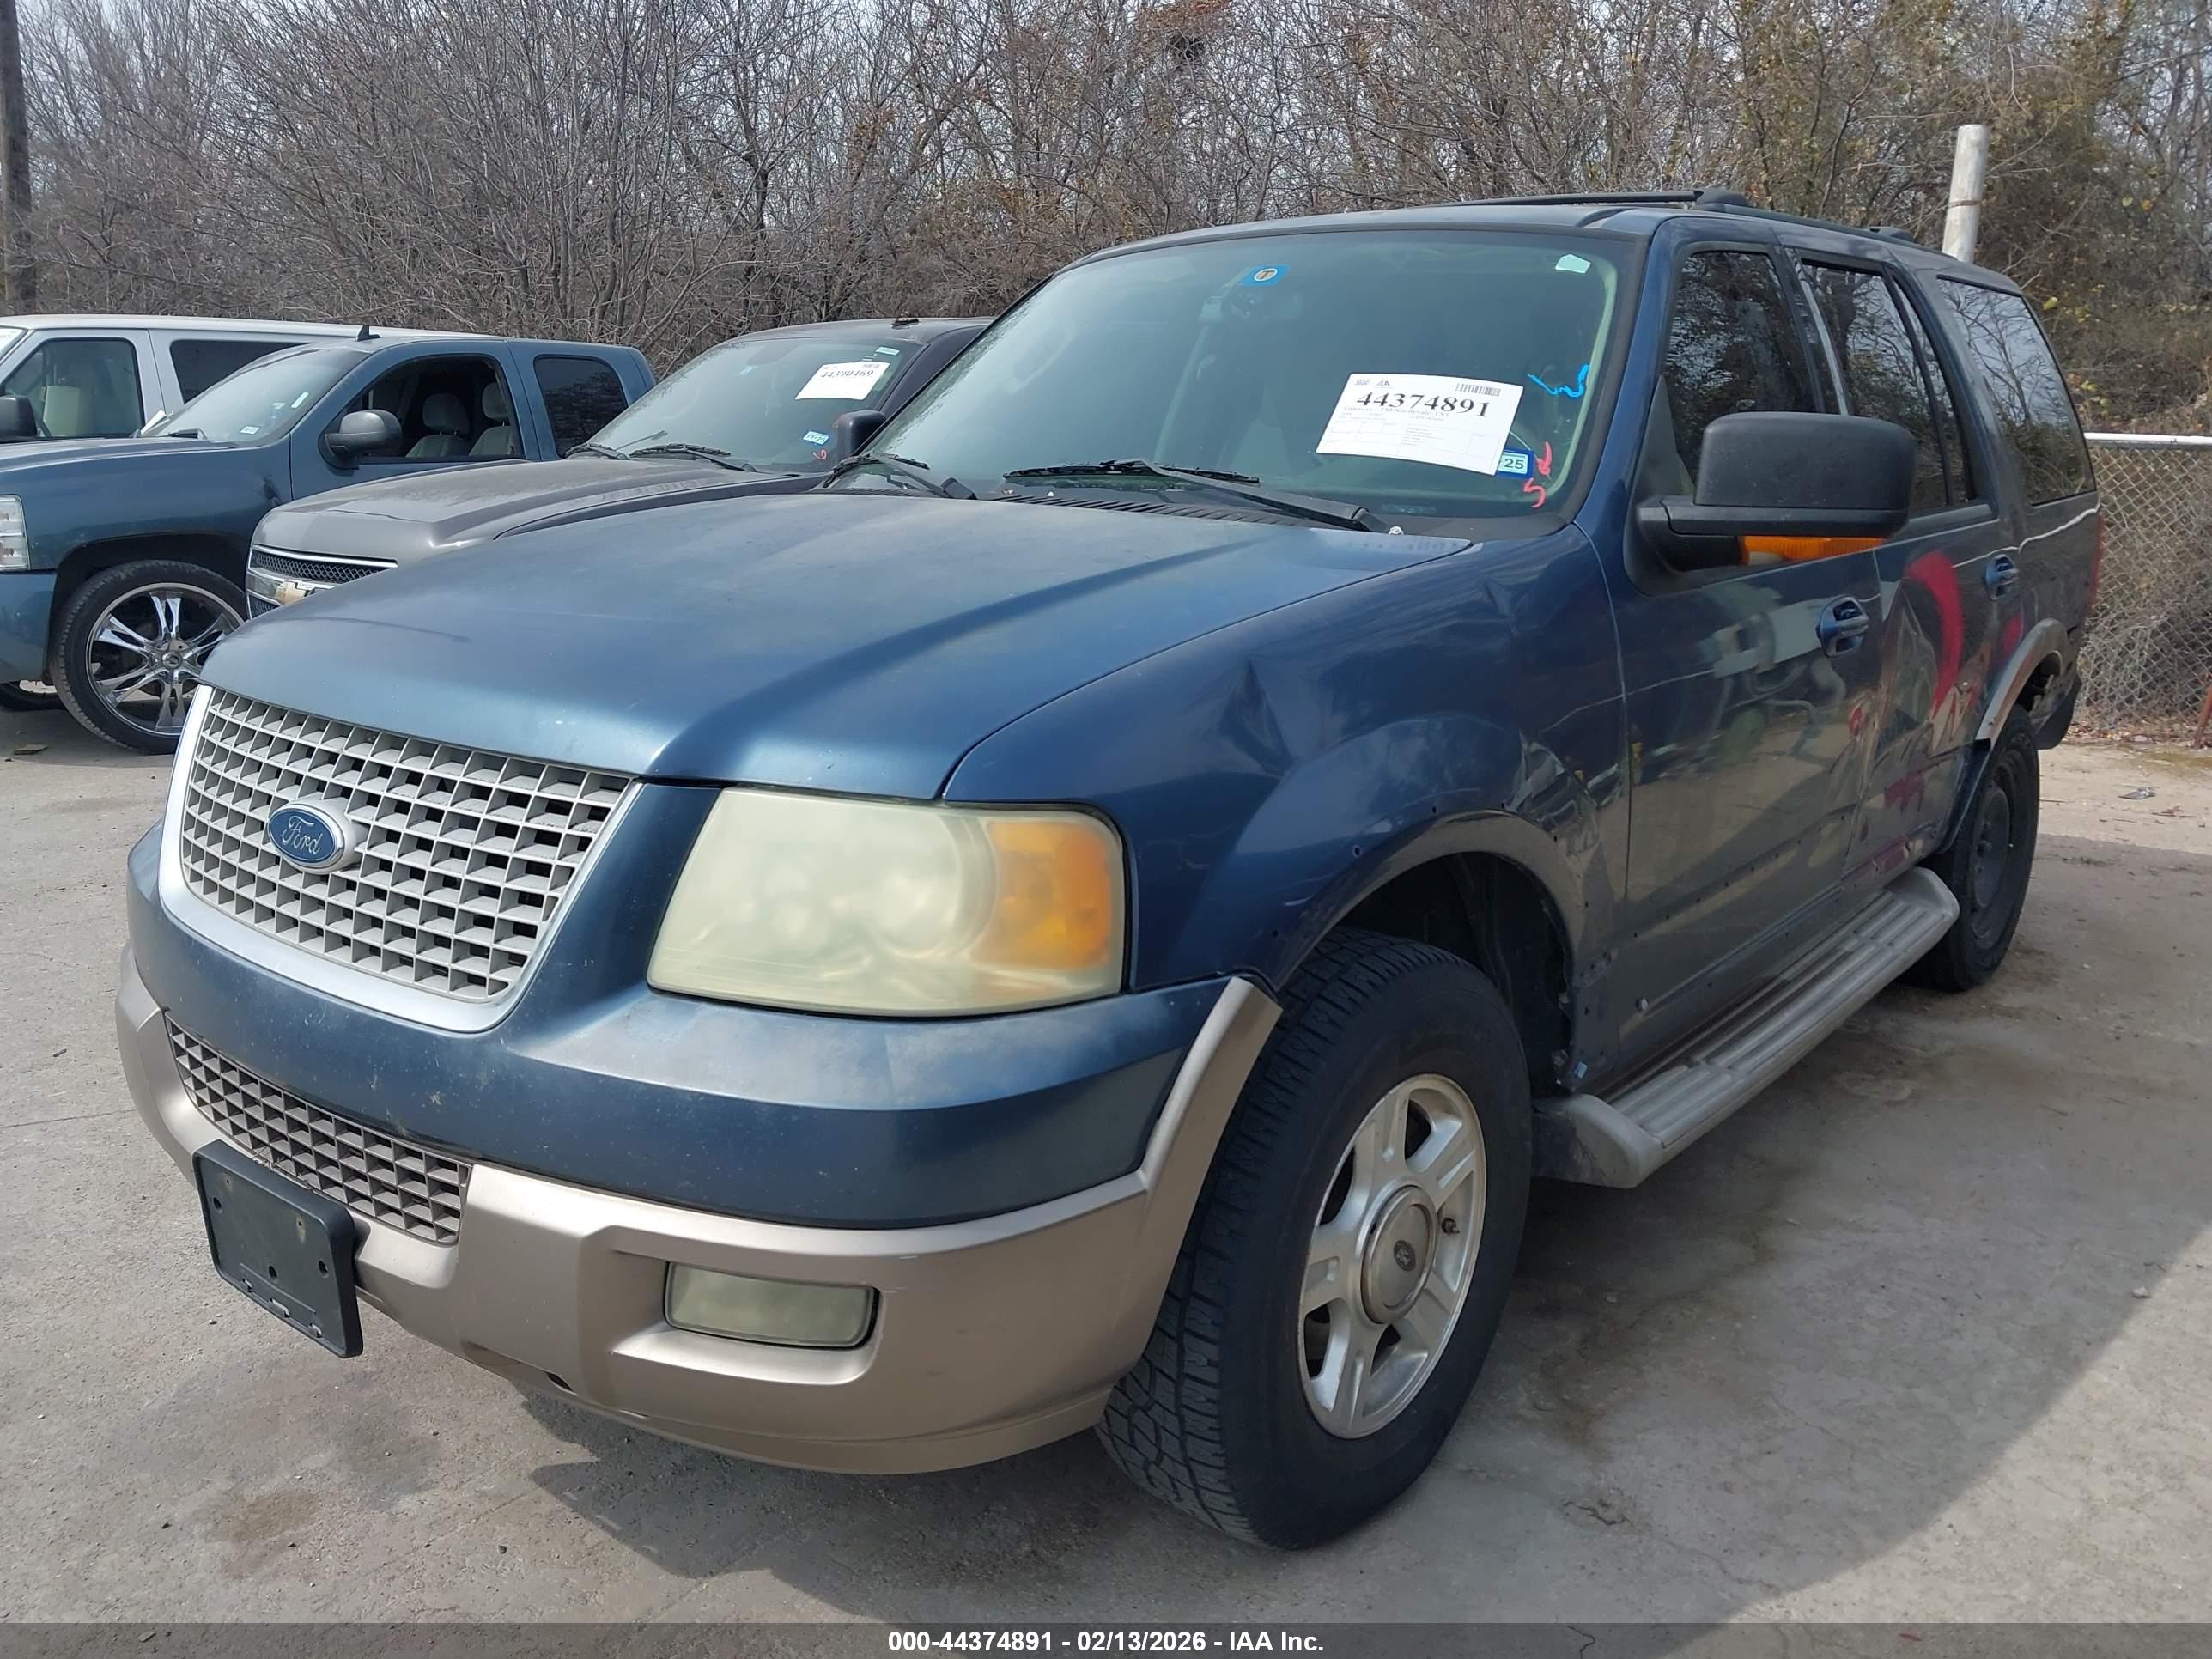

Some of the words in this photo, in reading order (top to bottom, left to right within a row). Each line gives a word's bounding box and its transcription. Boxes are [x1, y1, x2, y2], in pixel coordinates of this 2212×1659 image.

[1357, 392, 1490, 417] 44374891
[1504, 458, 1524, 470] 25
[282, 815, 323, 855] Ford
